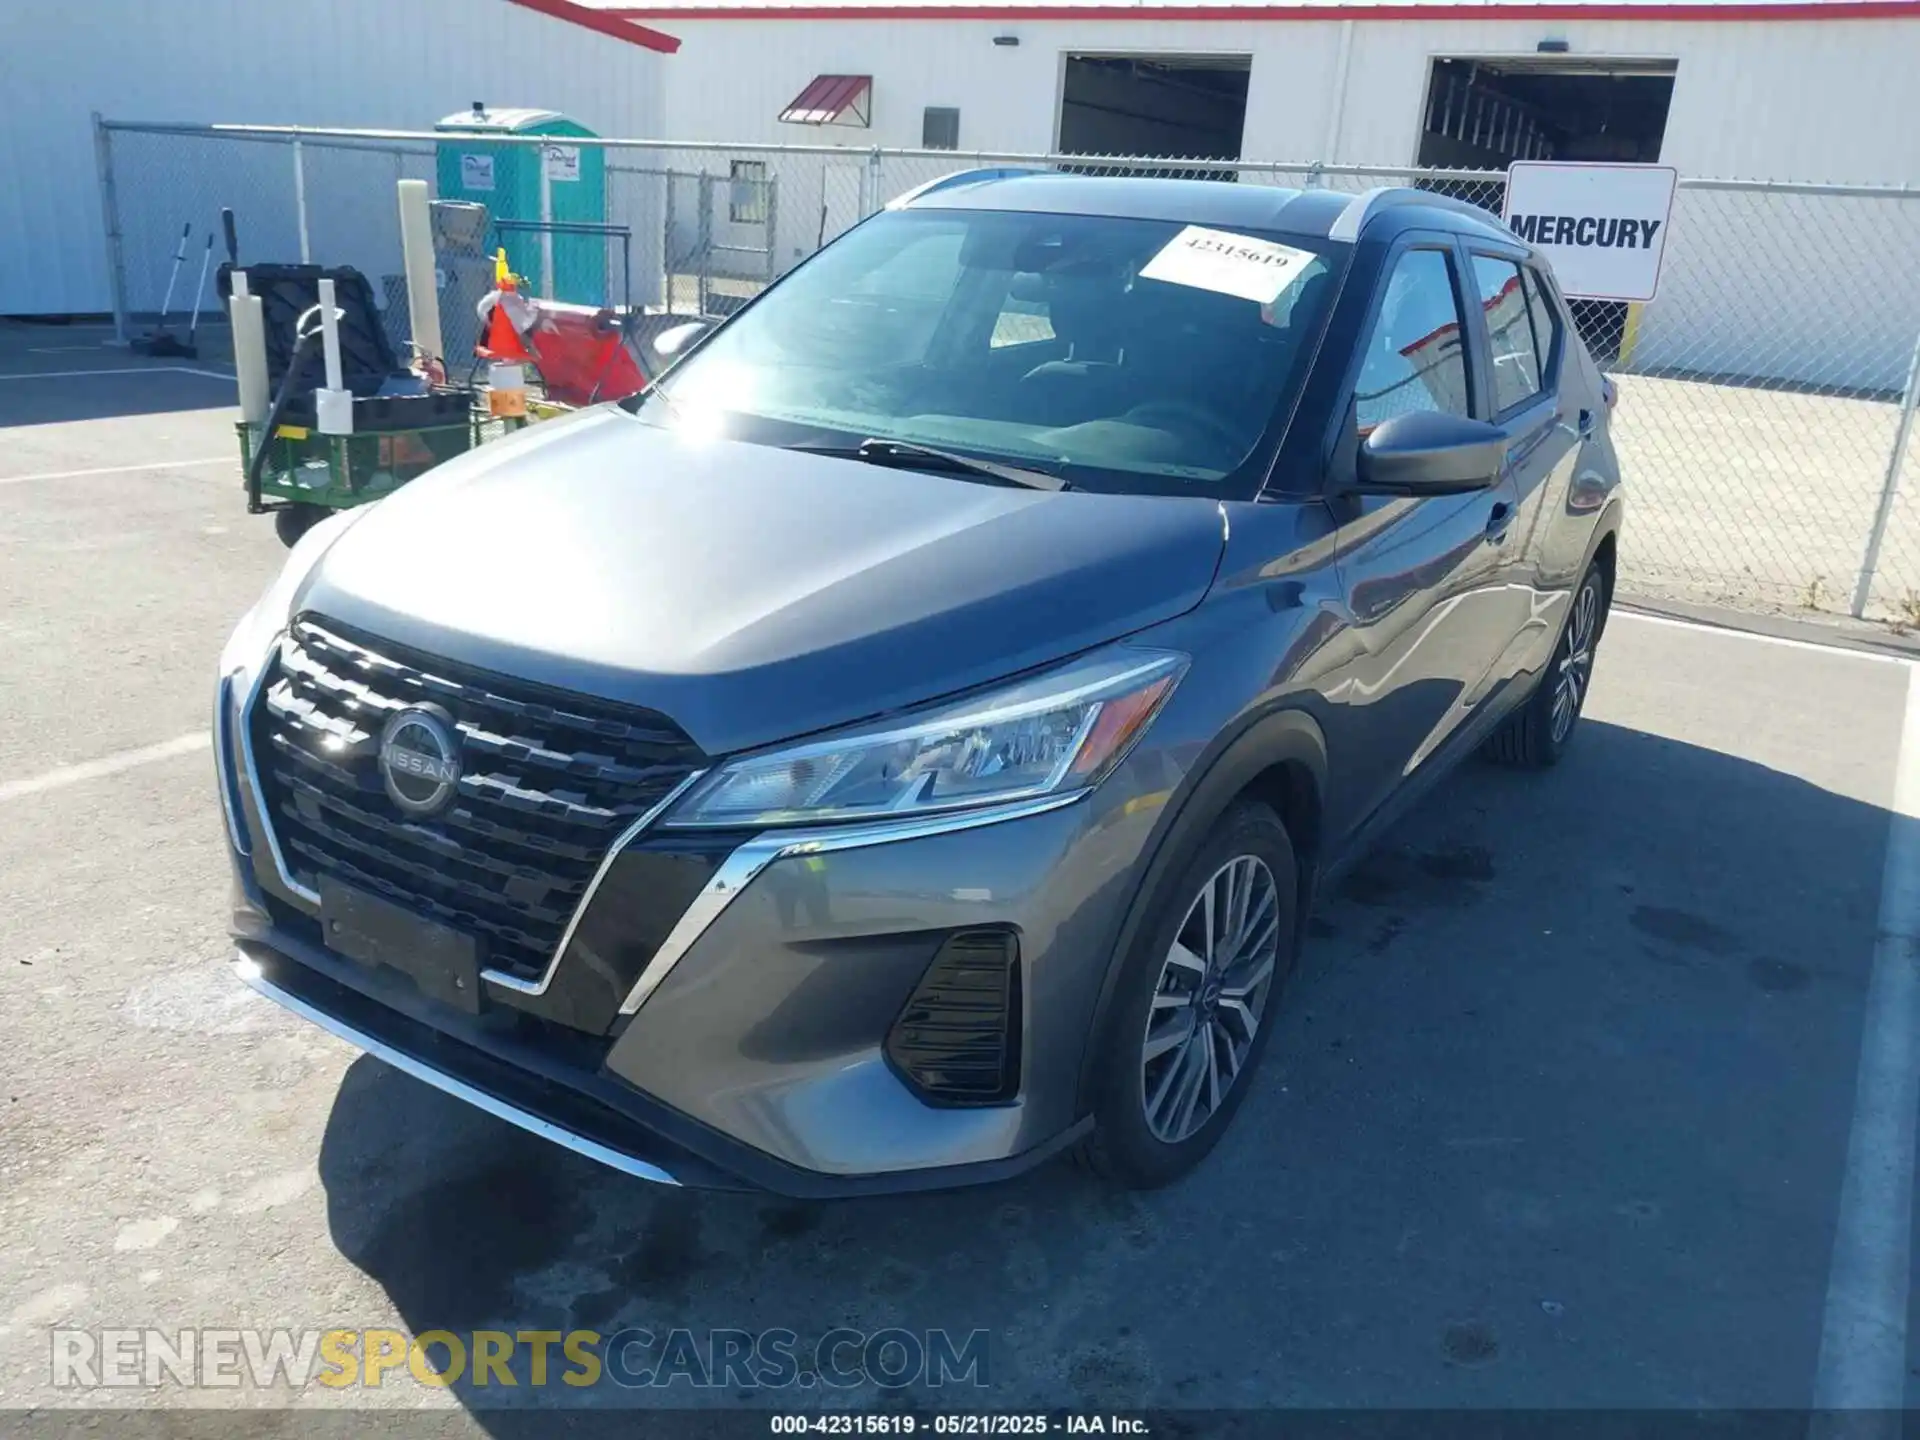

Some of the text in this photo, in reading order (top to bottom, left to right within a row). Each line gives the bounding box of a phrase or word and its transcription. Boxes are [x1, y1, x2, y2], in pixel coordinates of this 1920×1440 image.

[1510, 214, 1662, 249] MERCURY
[1184, 238, 1289, 268] 42315619
[380, 743, 455, 781] NISSAN
